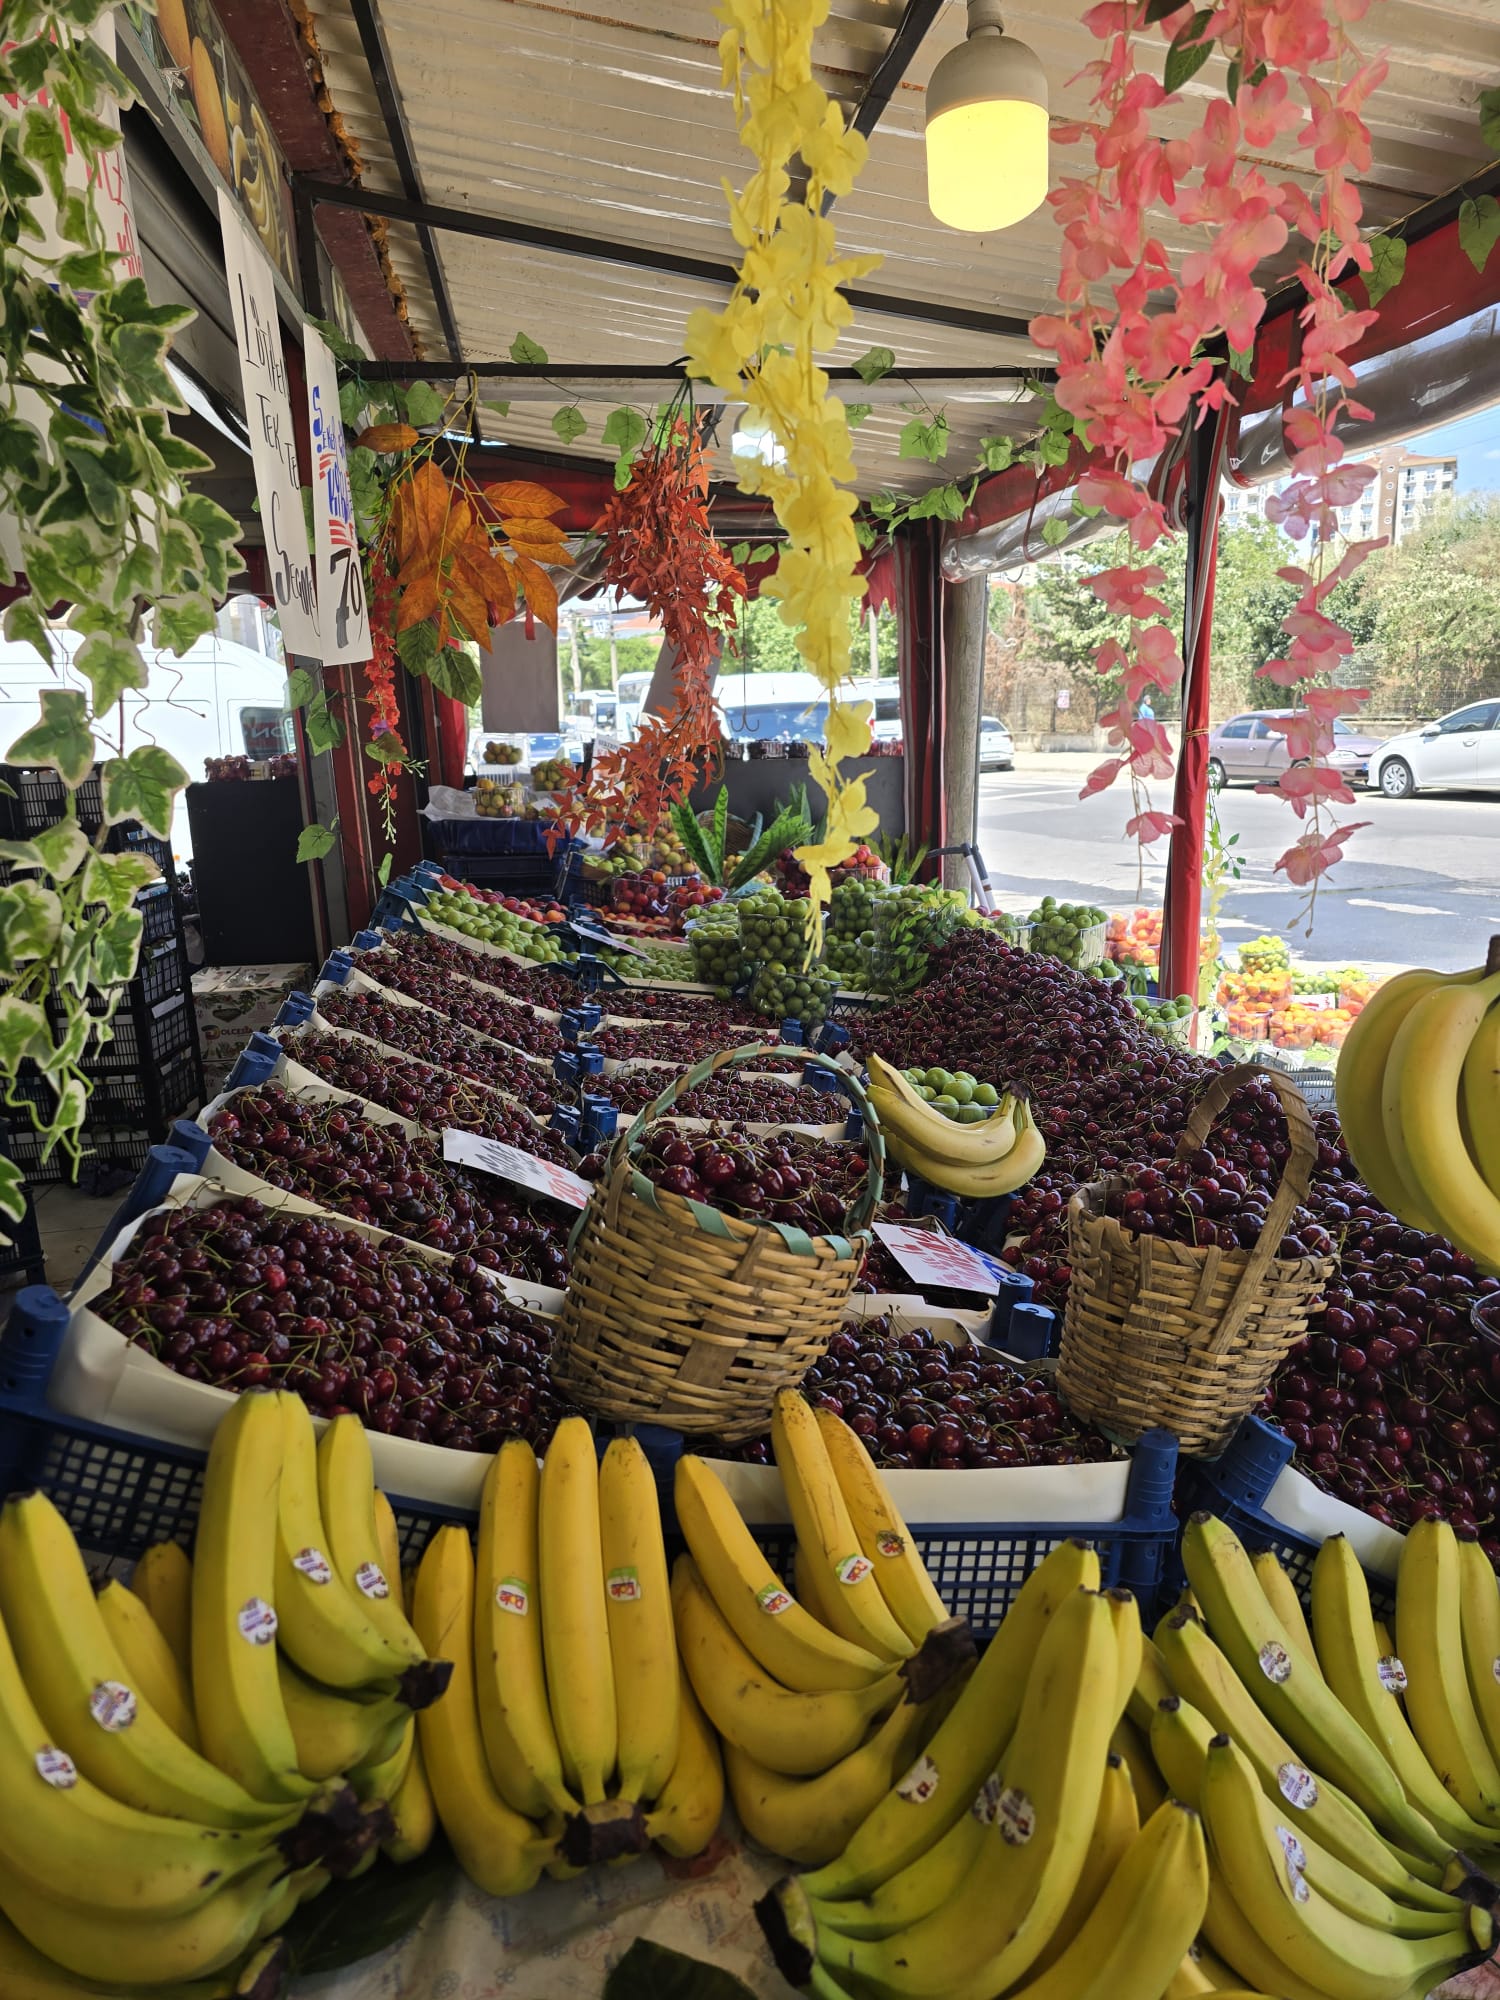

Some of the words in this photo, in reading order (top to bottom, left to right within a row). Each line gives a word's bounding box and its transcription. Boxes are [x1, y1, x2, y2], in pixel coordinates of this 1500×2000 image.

[256, 393, 285, 465] TEK
[611, 1582, 636, 1597] Dole
[499, 1591, 526, 1610] Dole
[766, 1594, 789, 1611] Dole
